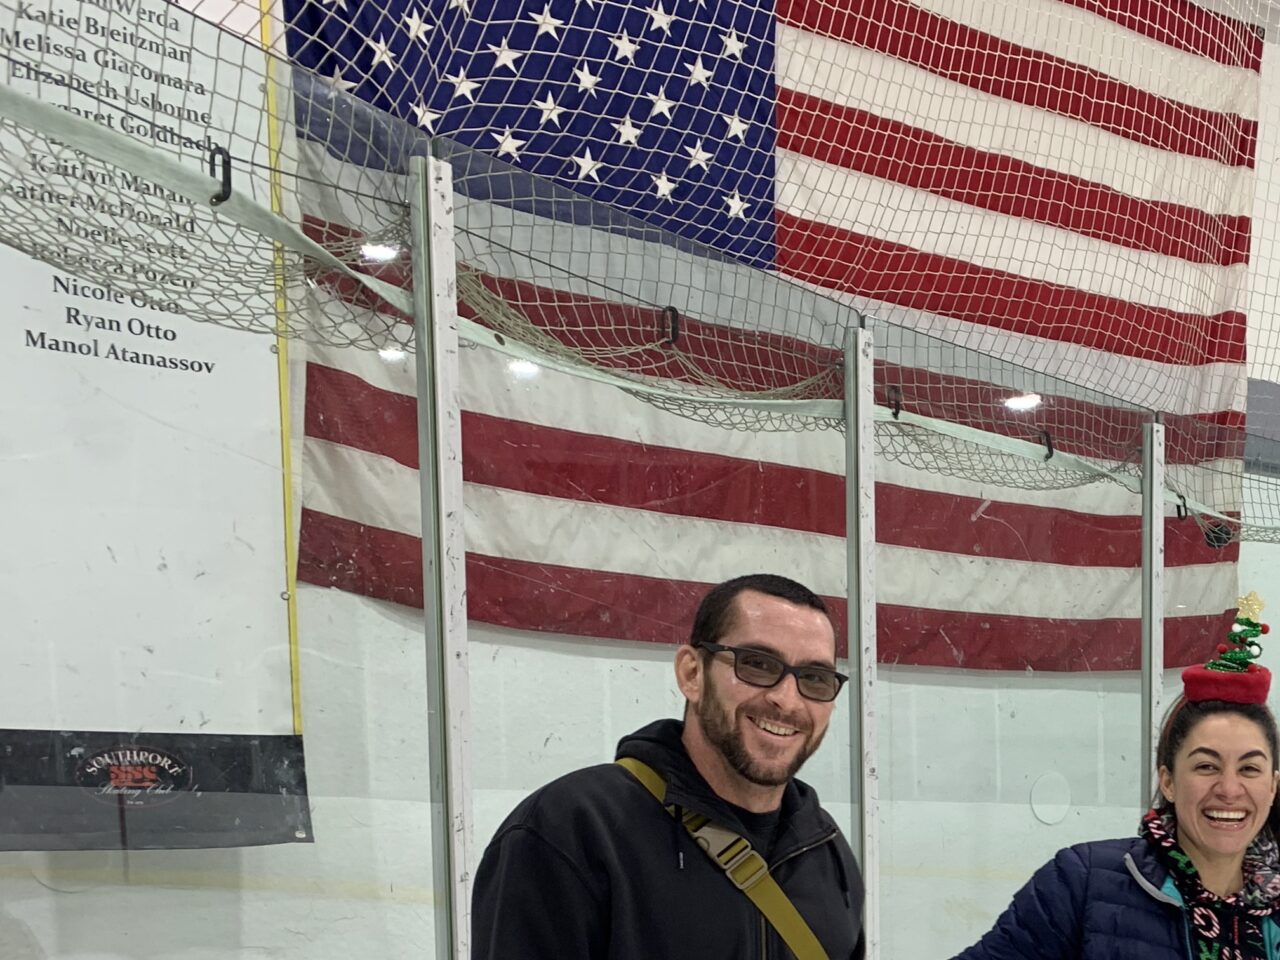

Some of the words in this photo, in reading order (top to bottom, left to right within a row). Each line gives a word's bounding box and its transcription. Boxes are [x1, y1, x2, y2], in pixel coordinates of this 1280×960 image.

[17, 1, 79, 31] Katie
[86, 16, 192, 63] Breitzman
[0, 28, 87, 62] Melissa
[94, 50, 206, 96] Giacomara
[12, 61, 118, 101] Elizabeth
[1, 184, 83, 208] eather
[53, 274, 125, 304] Nicole
[130, 289, 182, 315] Otto
[65, 306, 122, 331] Ryan
[127, 318, 177, 342] Otto
[24, 329, 100, 357] Manol
[104, 343, 216, 374] Atanassov
[86, 749, 184, 776] SOUTHPORT
